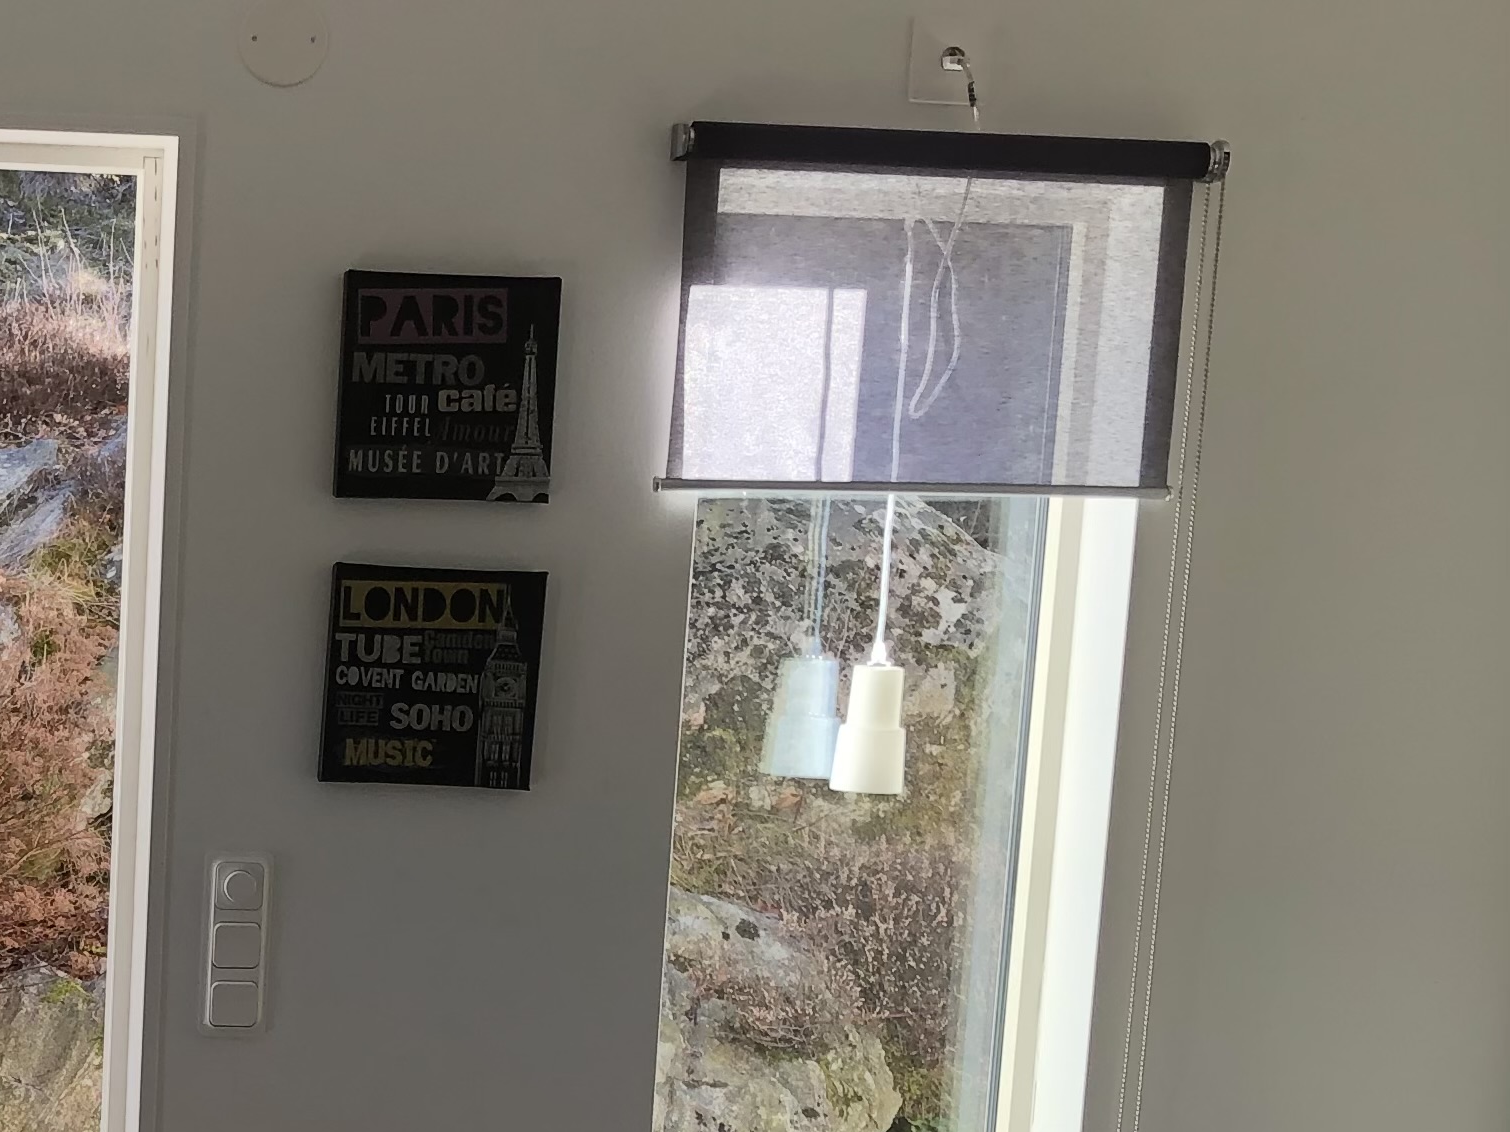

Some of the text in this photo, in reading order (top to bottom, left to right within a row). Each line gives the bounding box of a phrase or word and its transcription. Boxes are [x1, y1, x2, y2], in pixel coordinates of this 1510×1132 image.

[360, 295, 504, 337] PARIS
[351, 351, 485, 386] METRO
[385, 394, 429, 415] TOUR
[437, 383, 518, 412] café
[370, 416, 431, 437] EIFFEL
[348, 444, 505, 475] MUSÉE D'ART
[343, 586, 504, 623] LONDON
[335, 632, 423, 664] TUBE
[335, 665, 479, 694] COVENT GARDEN
[337, 693, 382, 706] NIGHT
[340, 710, 377, 723] LIFE
[389, 702, 474, 732] SOHO
[343, 738, 434, 767] MUSIC
